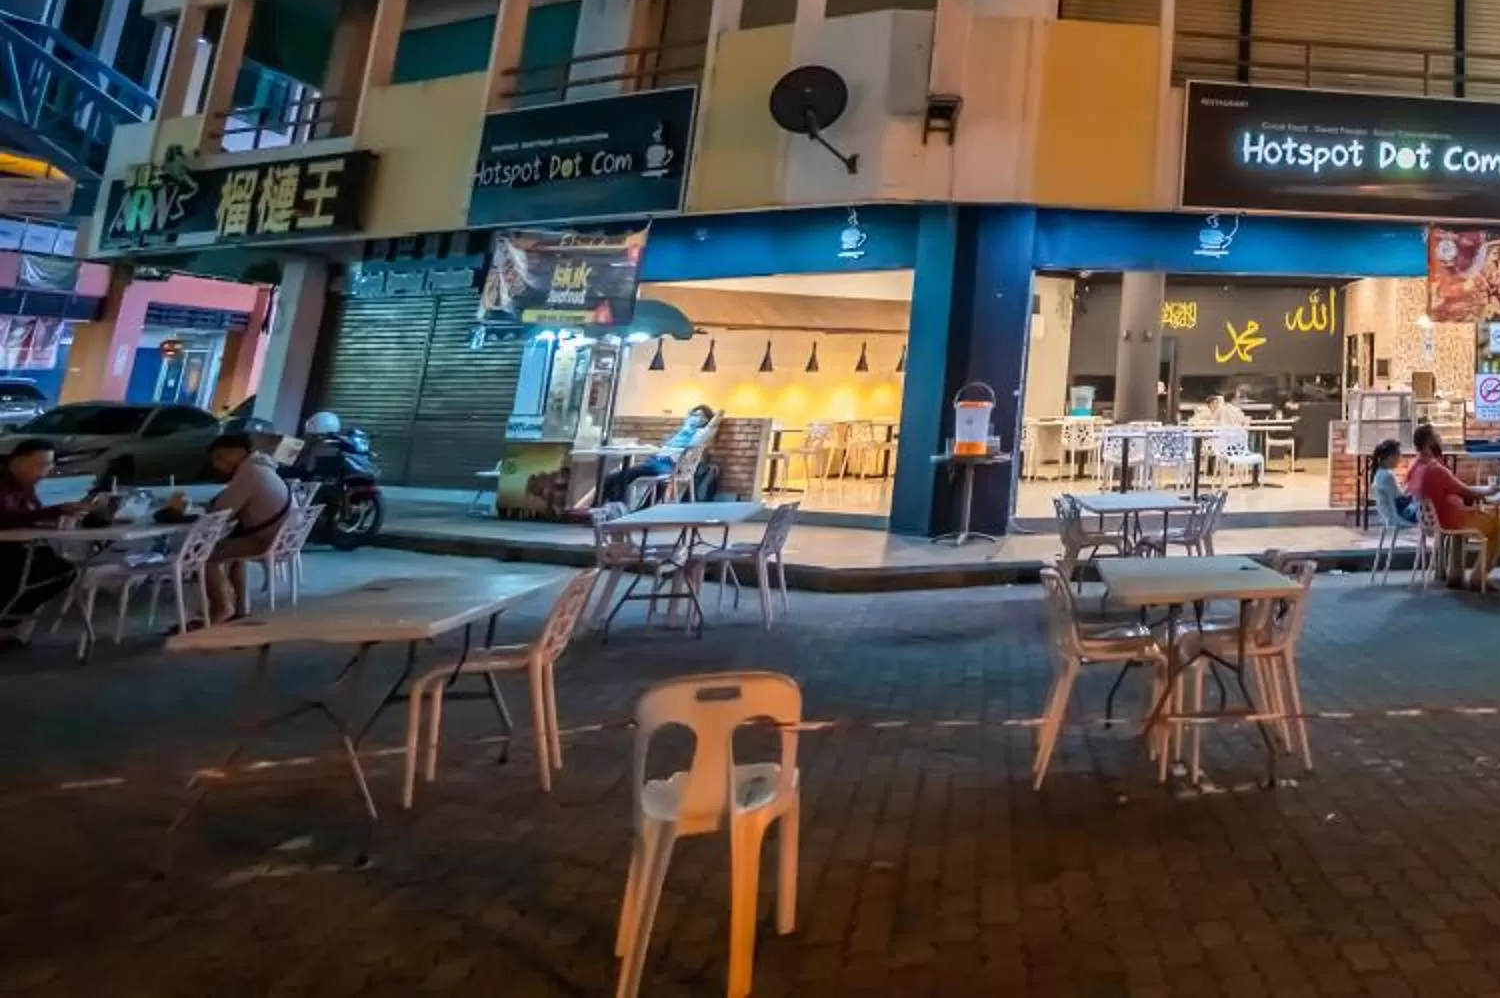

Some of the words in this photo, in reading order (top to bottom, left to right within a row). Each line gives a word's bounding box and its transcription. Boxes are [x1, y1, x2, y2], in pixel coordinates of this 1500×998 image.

[469, 154, 543, 187] Hotspot
[549, 152, 583, 180] Dot
[591, 150, 633, 176] Com
[1243, 132, 1364, 173] Hotspot
[1379, 140, 1431, 170] Dot
[1285, 287, 1337, 336] الله
[1215, 320, 1268, 364] محمد
